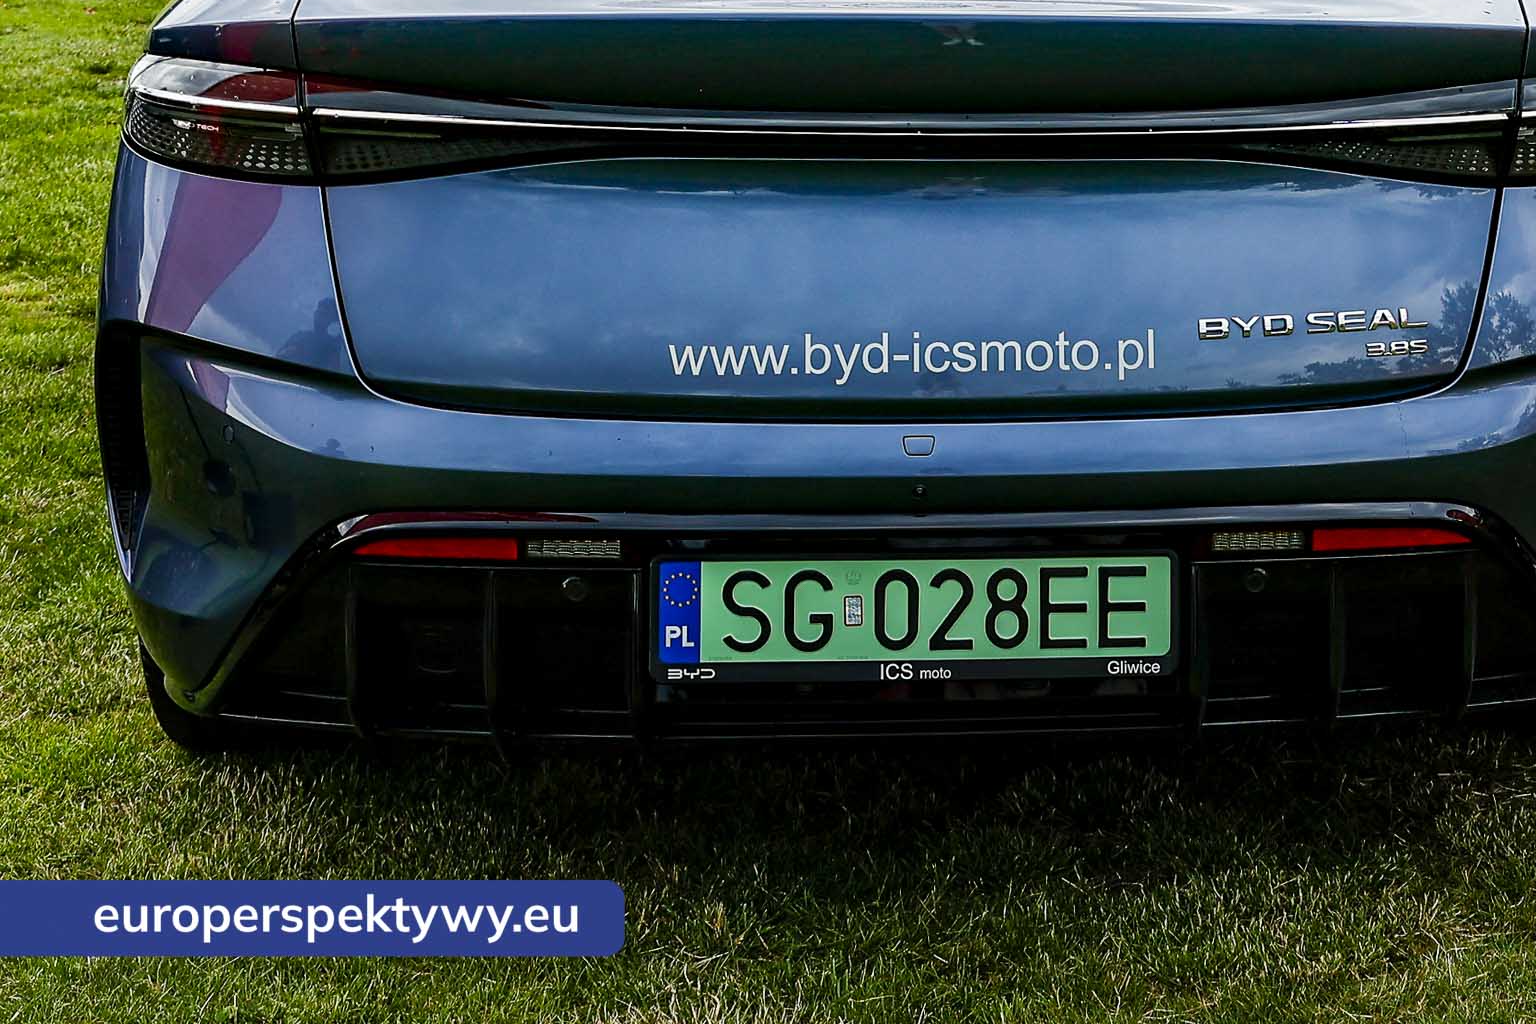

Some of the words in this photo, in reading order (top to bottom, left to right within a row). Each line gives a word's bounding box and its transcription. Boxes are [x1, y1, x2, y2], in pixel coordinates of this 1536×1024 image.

[1198, 314, 1295, 340] BYD
[1306, 307, 1428, 334] SEAL
[668, 329, 1156, 384] www.byd-icsmoto.pl
[1365, 339, 1428, 357] 3.8S
[722, 568, 834, 653] SG
[873, 564, 1148, 652] 028EE
[665, 625, 695, 648] PL
[667, 668, 716, 680] BYD
[880, 663, 914, 680] ICS
[919, 666, 952, 680] moto
[1107, 660, 1161, 675] Gliwice
